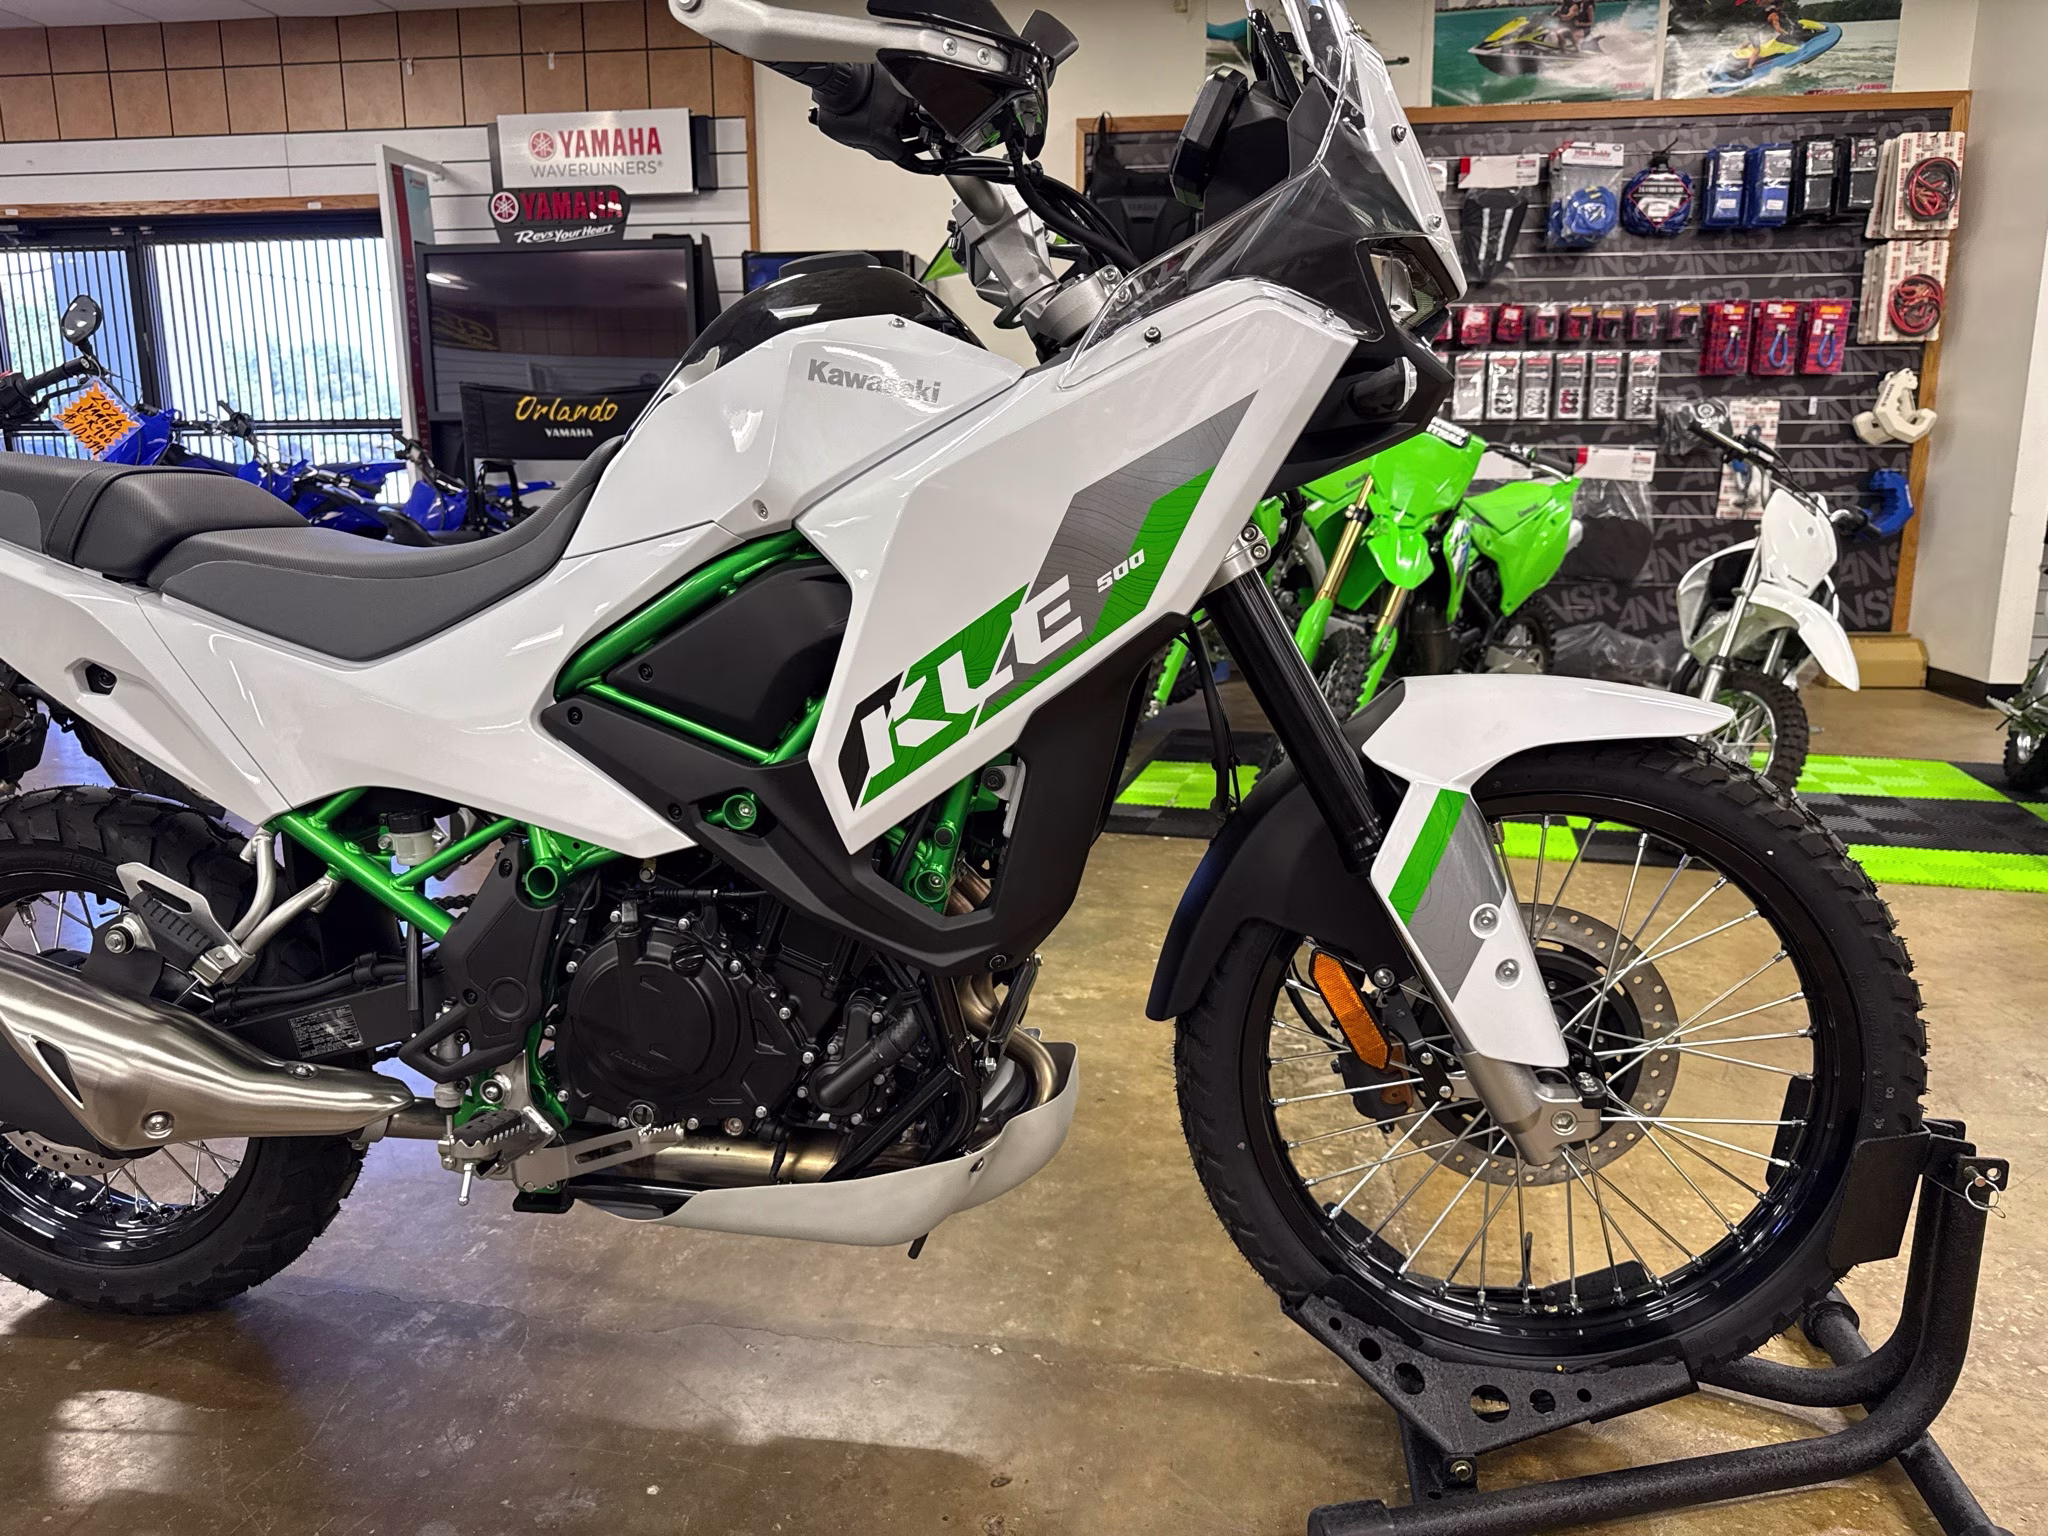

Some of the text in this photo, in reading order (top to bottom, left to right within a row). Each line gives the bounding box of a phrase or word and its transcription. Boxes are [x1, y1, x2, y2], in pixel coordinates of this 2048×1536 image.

[558, 126, 663, 159] YAMAHA
[520, 189, 624, 221] YAMAHA
[807, 358, 941, 404] Kawasaki
[91, 394, 124, 427] 2026
[515, 396, 618, 422] Orlando
[544, 427, 594, 438] YAMAHA
[860, 548, 1145, 778] KLE 500
